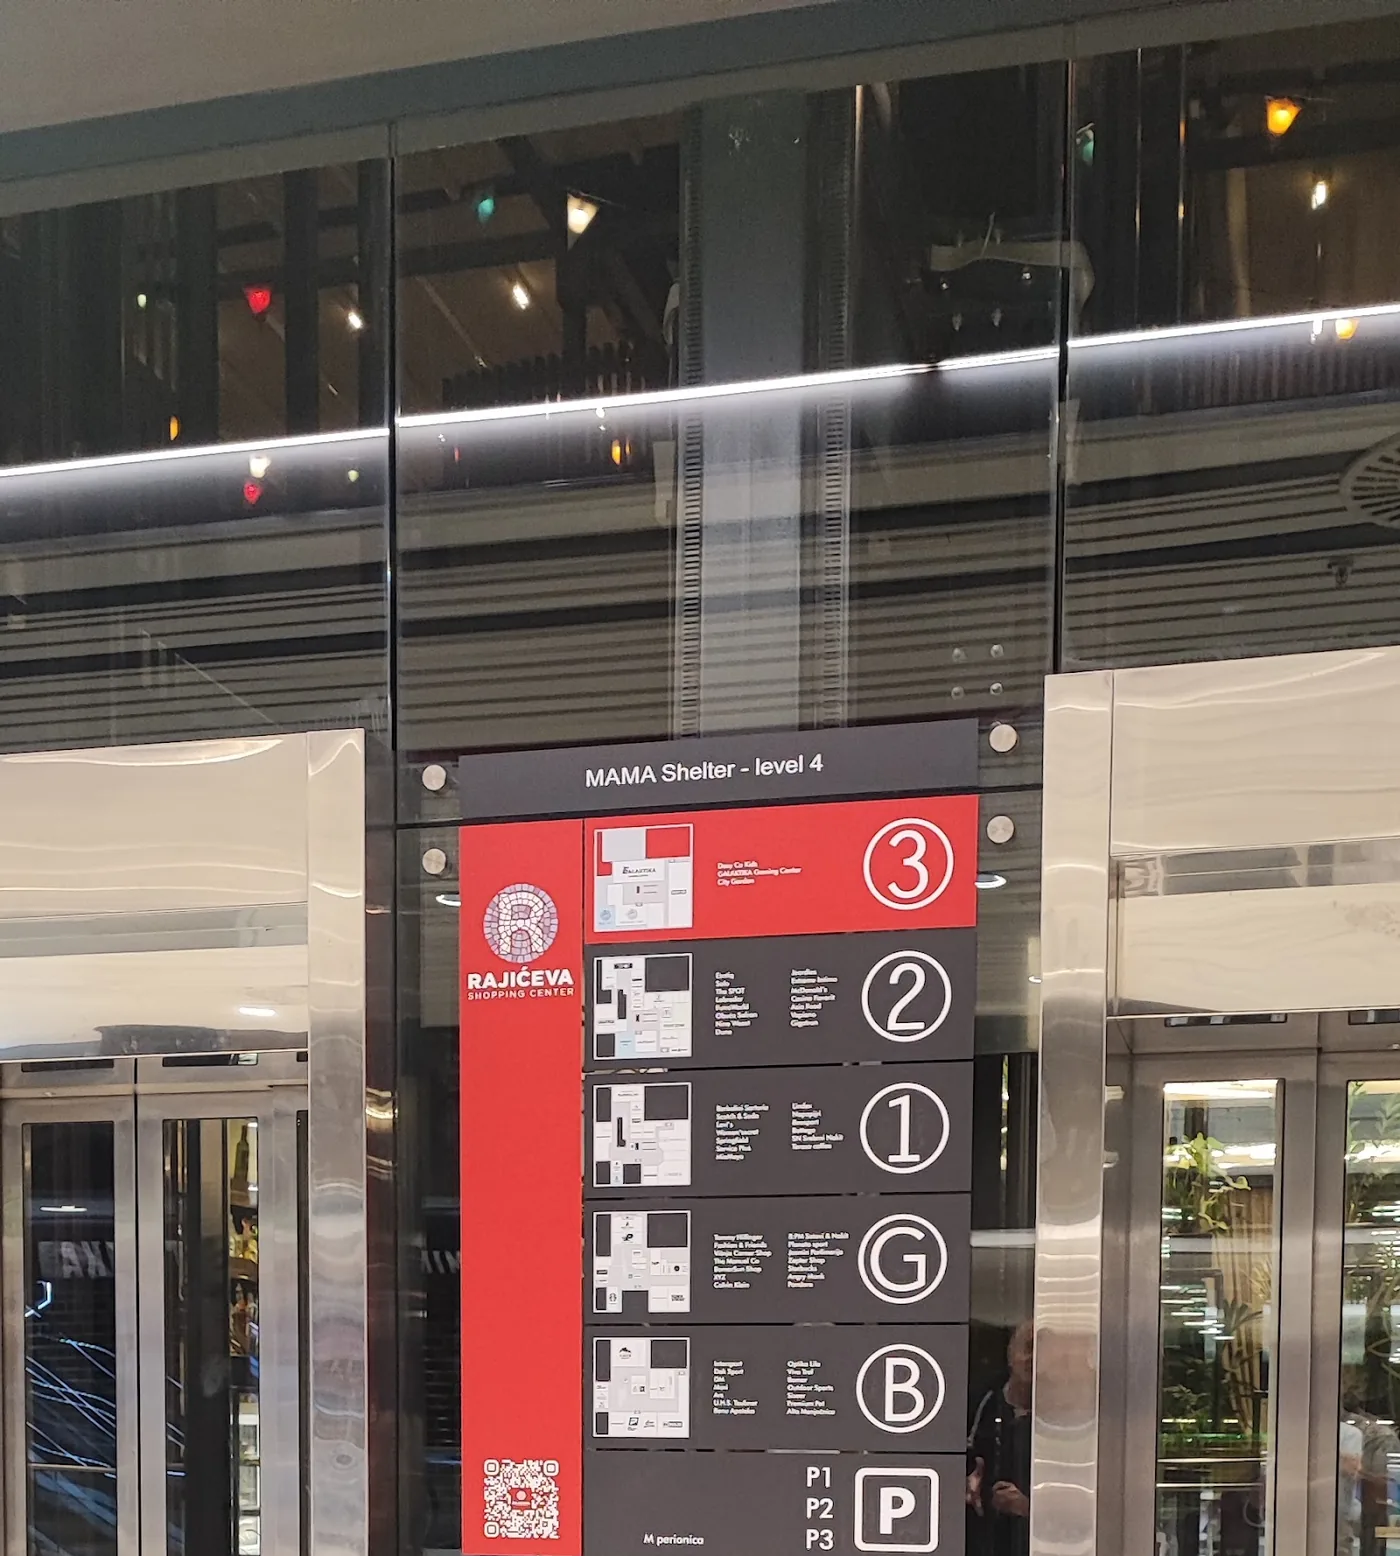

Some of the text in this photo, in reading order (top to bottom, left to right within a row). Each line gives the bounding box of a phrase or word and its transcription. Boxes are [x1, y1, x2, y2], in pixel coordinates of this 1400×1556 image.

[585, 765, 657, 787] MAMA
[661, 761, 735, 783] Shelter
[755, 754, 803, 776] level
[809, 753, 824, 772] 4
[887, 829, 929, 900] 3
[467, 966, 574, 990] RAJIĆEVA
[468, 988, 574, 1001] SHOPPING CENTER
[887, 962, 926, 1031] 2
[888, 1094, 921, 1163] 1
[870, 1226, 927, 1292] G
[884, 1357, 925, 1422] B
[806, 1466, 831, 1488] P1
[806, 1497, 834, 1520] P2
[879, 1487, 916, 1535] P
[643, 1533, 704, 1546] M perionica
[805, 1529, 834, 1550] P3
